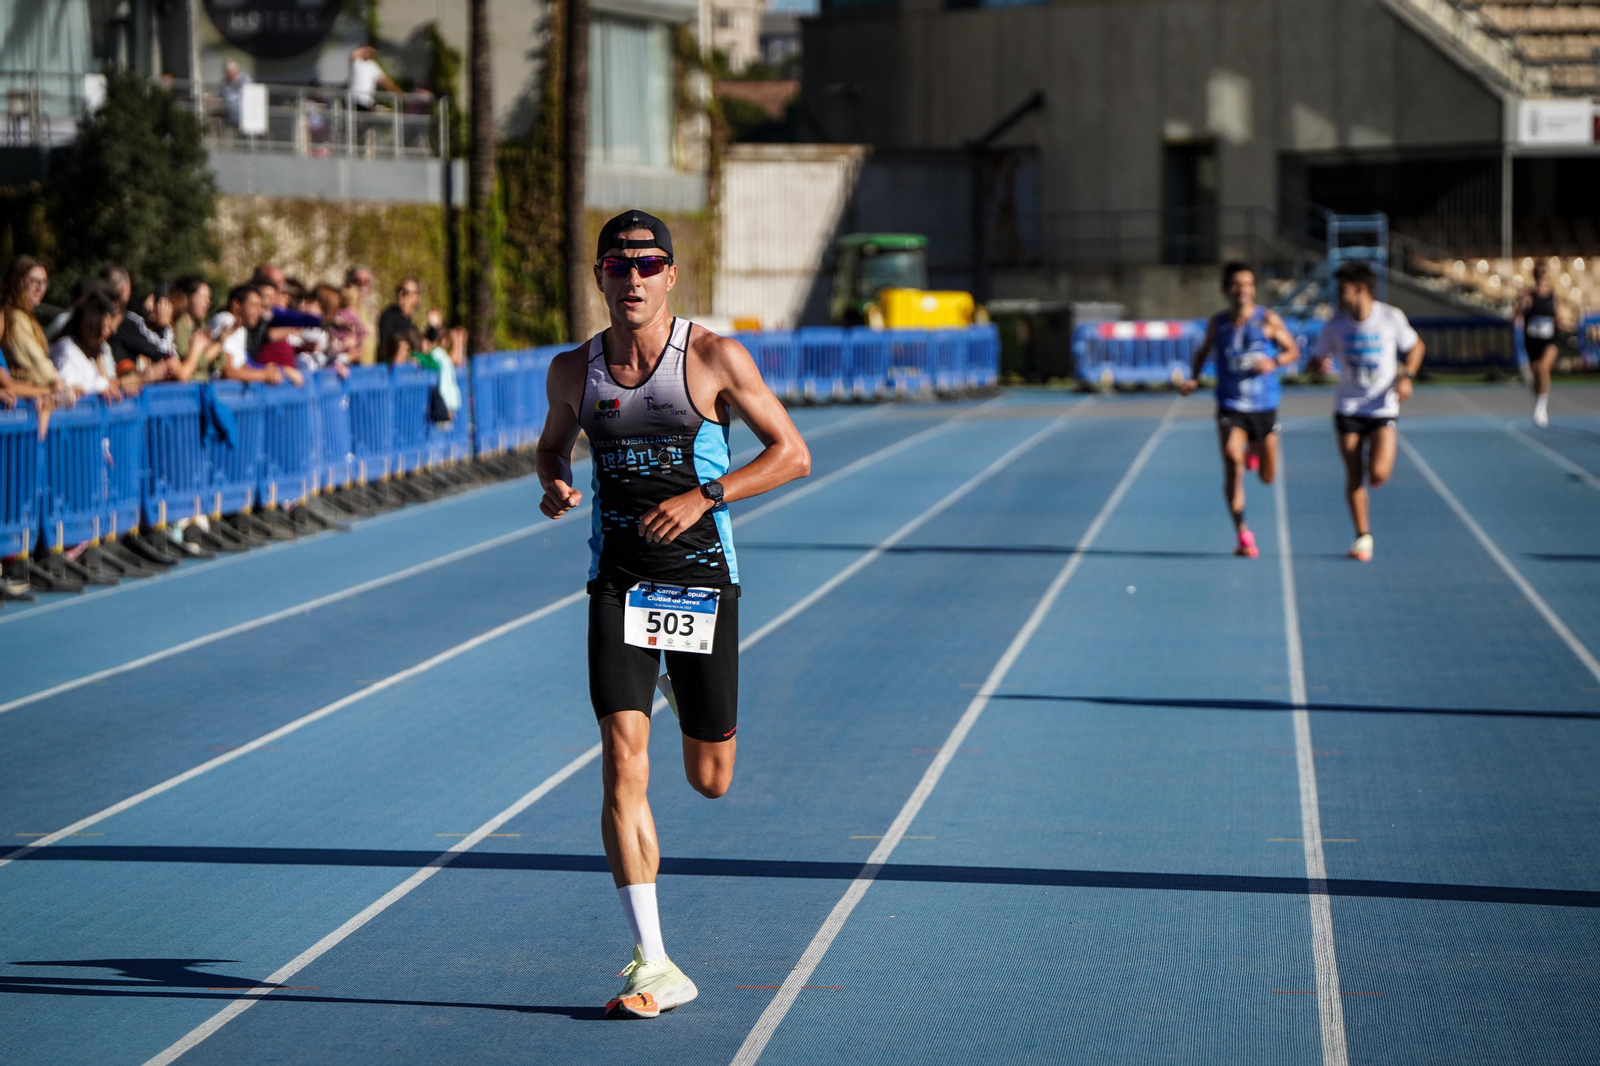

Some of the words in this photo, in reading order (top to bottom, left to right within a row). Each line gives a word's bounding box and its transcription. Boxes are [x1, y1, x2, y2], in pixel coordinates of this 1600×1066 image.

[230, 10, 317, 28] HOTELS
[647, 595, 671, 603] Ciudad
[646, 611, 695, 636] 503
